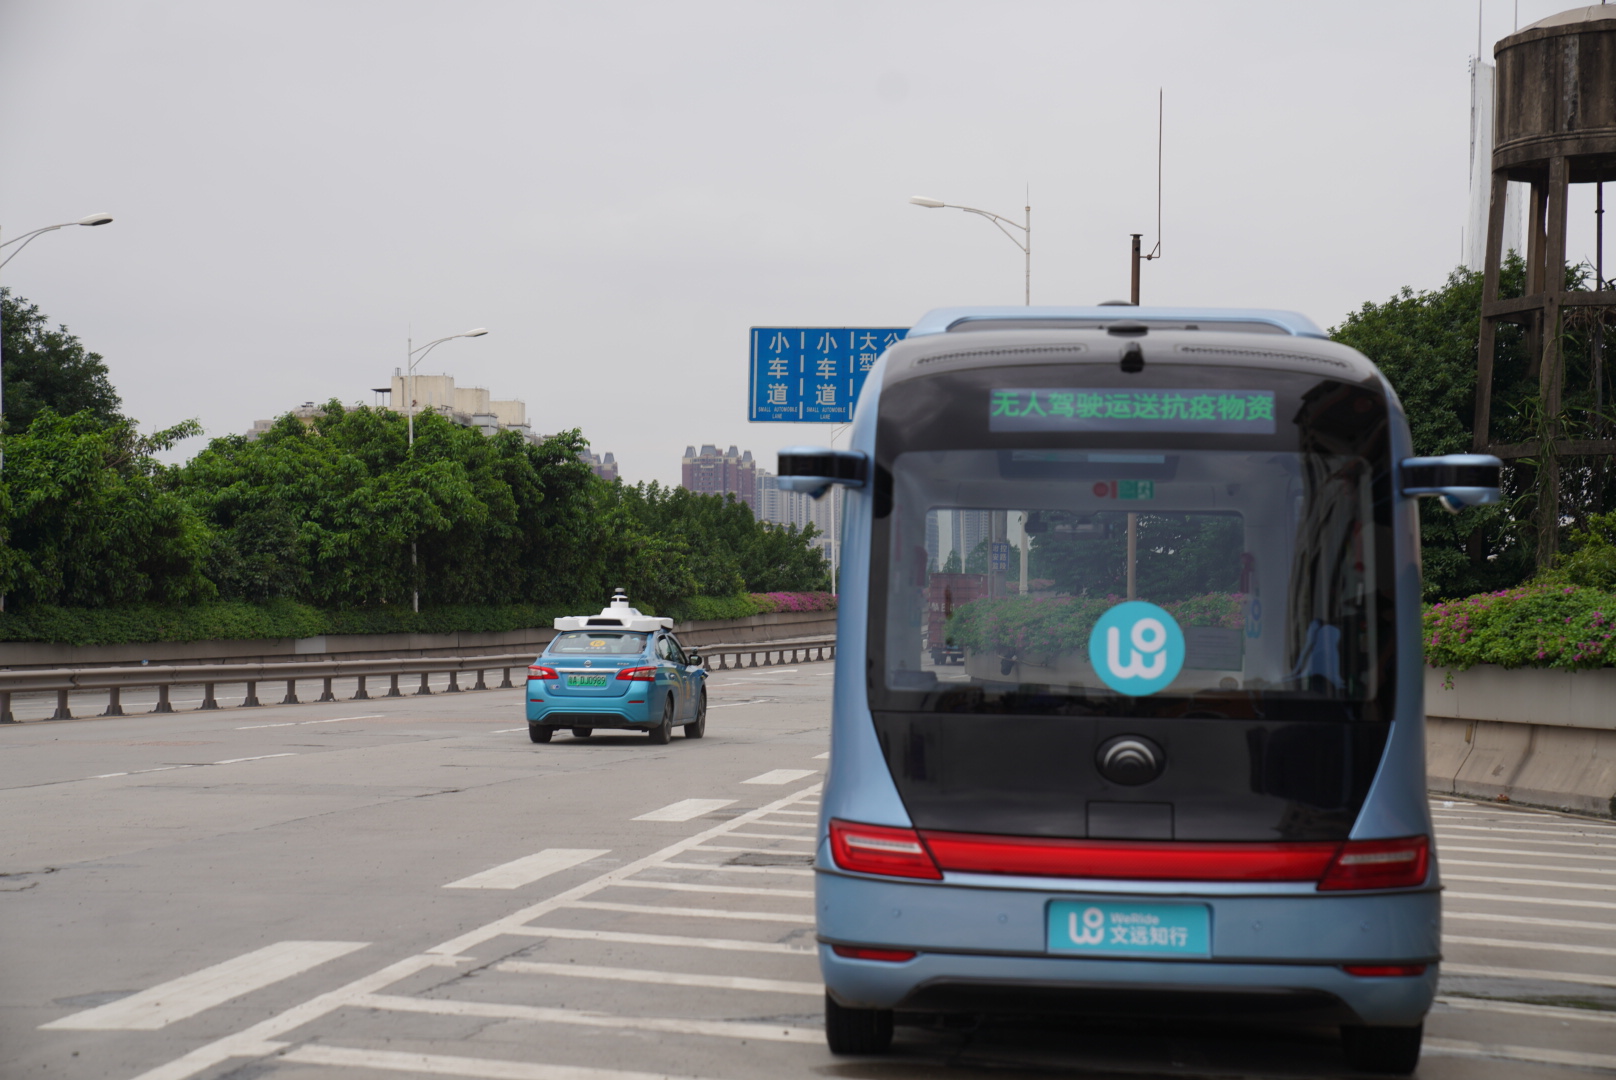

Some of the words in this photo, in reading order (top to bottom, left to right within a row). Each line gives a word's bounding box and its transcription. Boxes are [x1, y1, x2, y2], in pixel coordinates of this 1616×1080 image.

[767, 331, 790, 405] 小车道
[815, 332, 838, 405] 小车道
[991, 391, 1274, 420] 无人驾驶运送抗疫物资
[1109, 911, 1160, 926] WeRide
[1109, 926, 1188, 947] 文远知行
